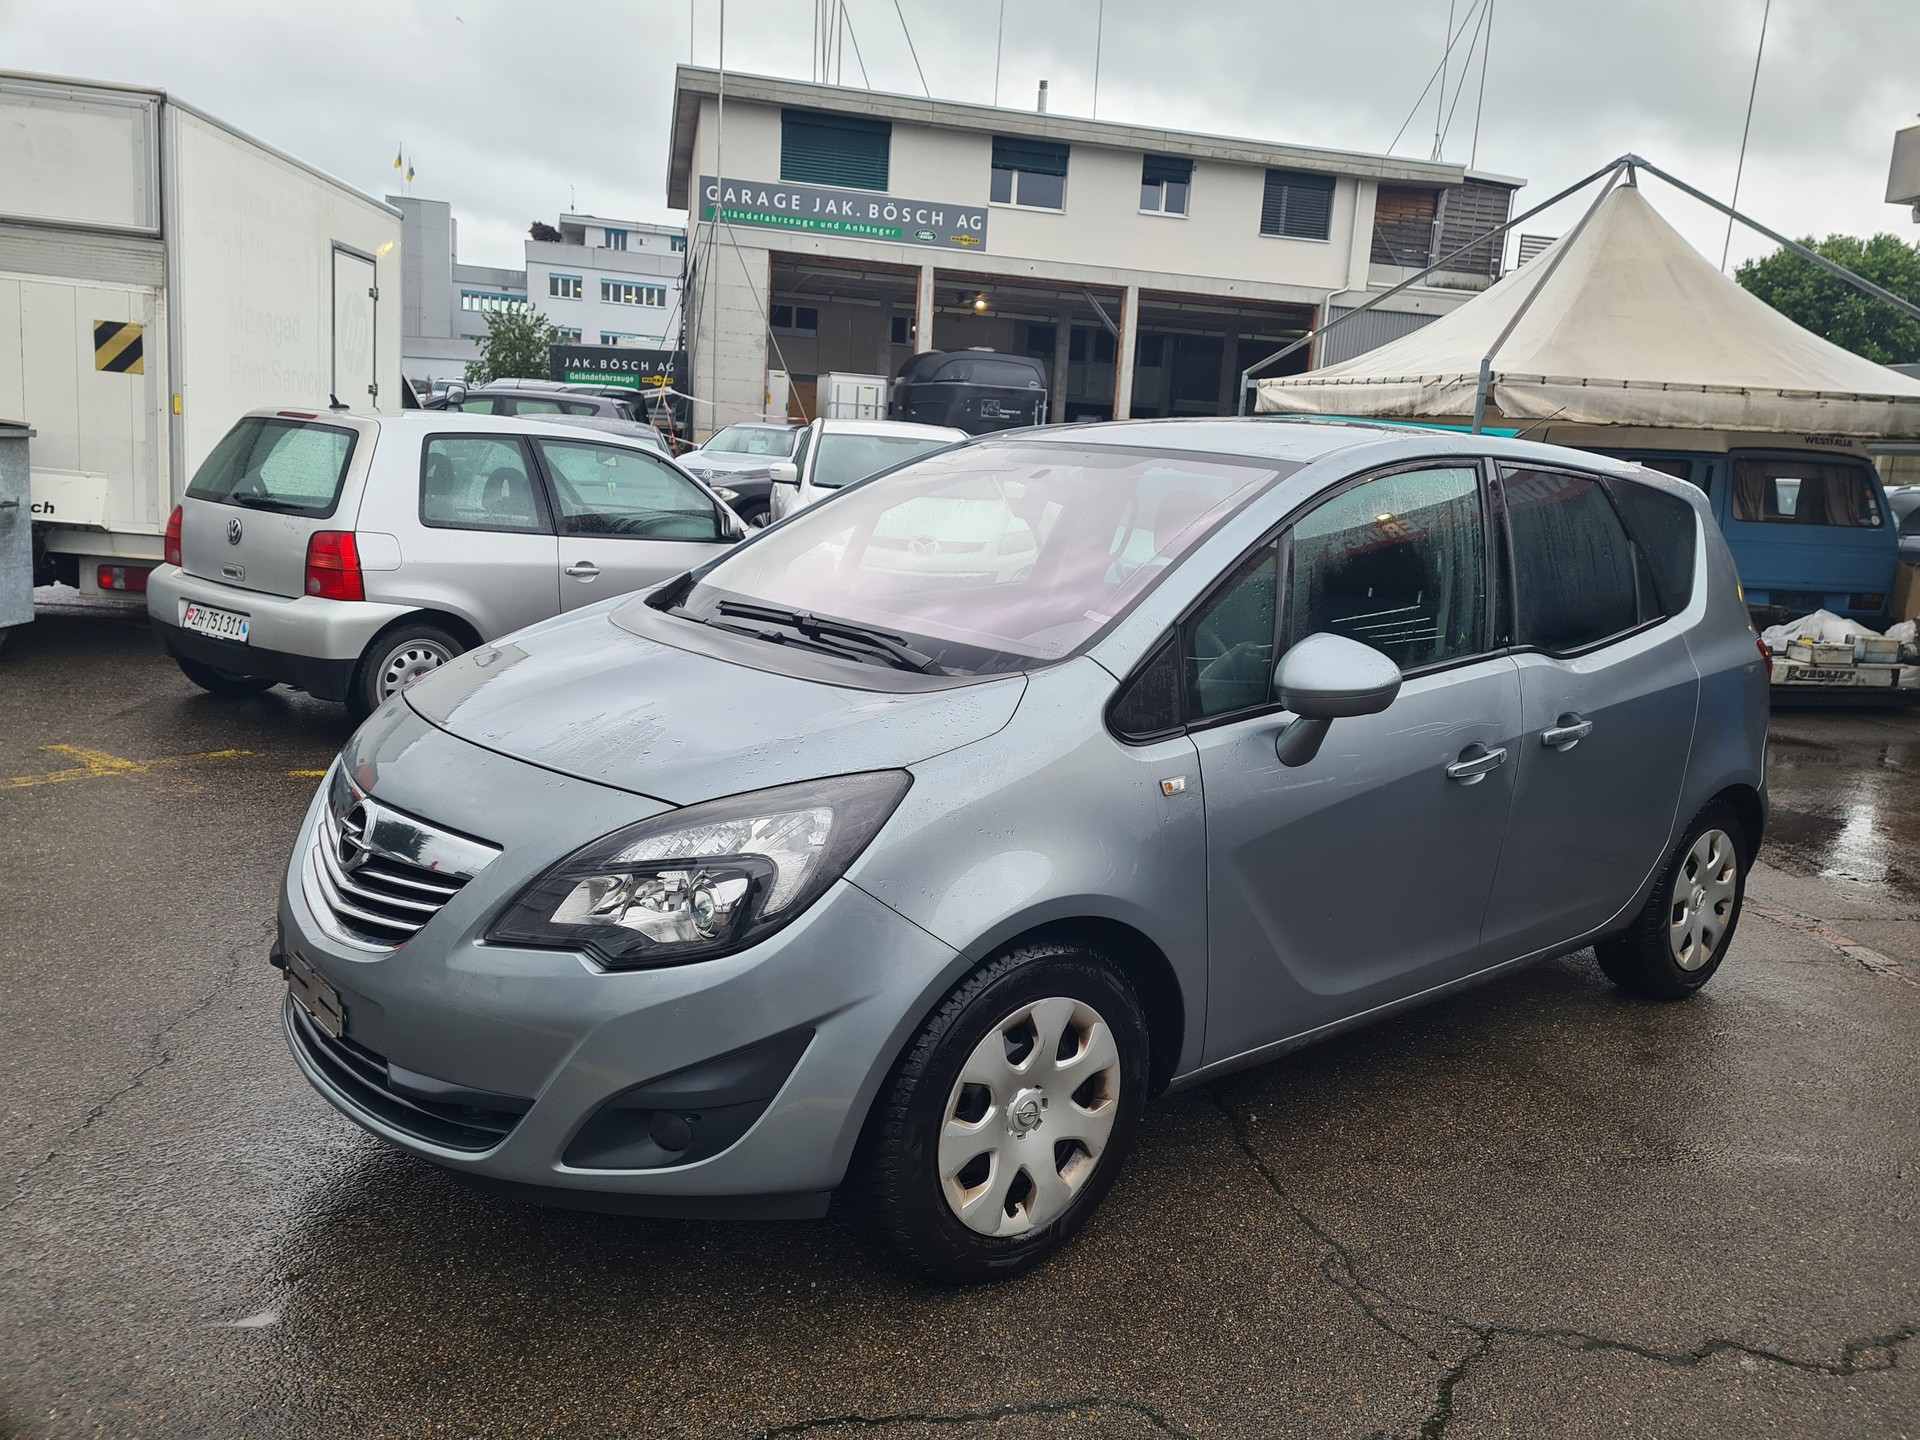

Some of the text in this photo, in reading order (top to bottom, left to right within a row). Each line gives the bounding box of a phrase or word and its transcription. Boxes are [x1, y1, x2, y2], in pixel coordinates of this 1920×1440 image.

[706, 185, 982, 230] GARAGE JAK. BÖSCH AG
[714, 207, 896, 236] eländefahrzeuge und Anhänger
[229, 297, 300, 347] Managed
[272, 360, 329, 396] Services
[564, 357, 675, 372] JAK. BÖSCH AG
[569, 371, 634, 383] Geländefahrzeuge
[1804, 436, 1852, 448] WESTFALIA
